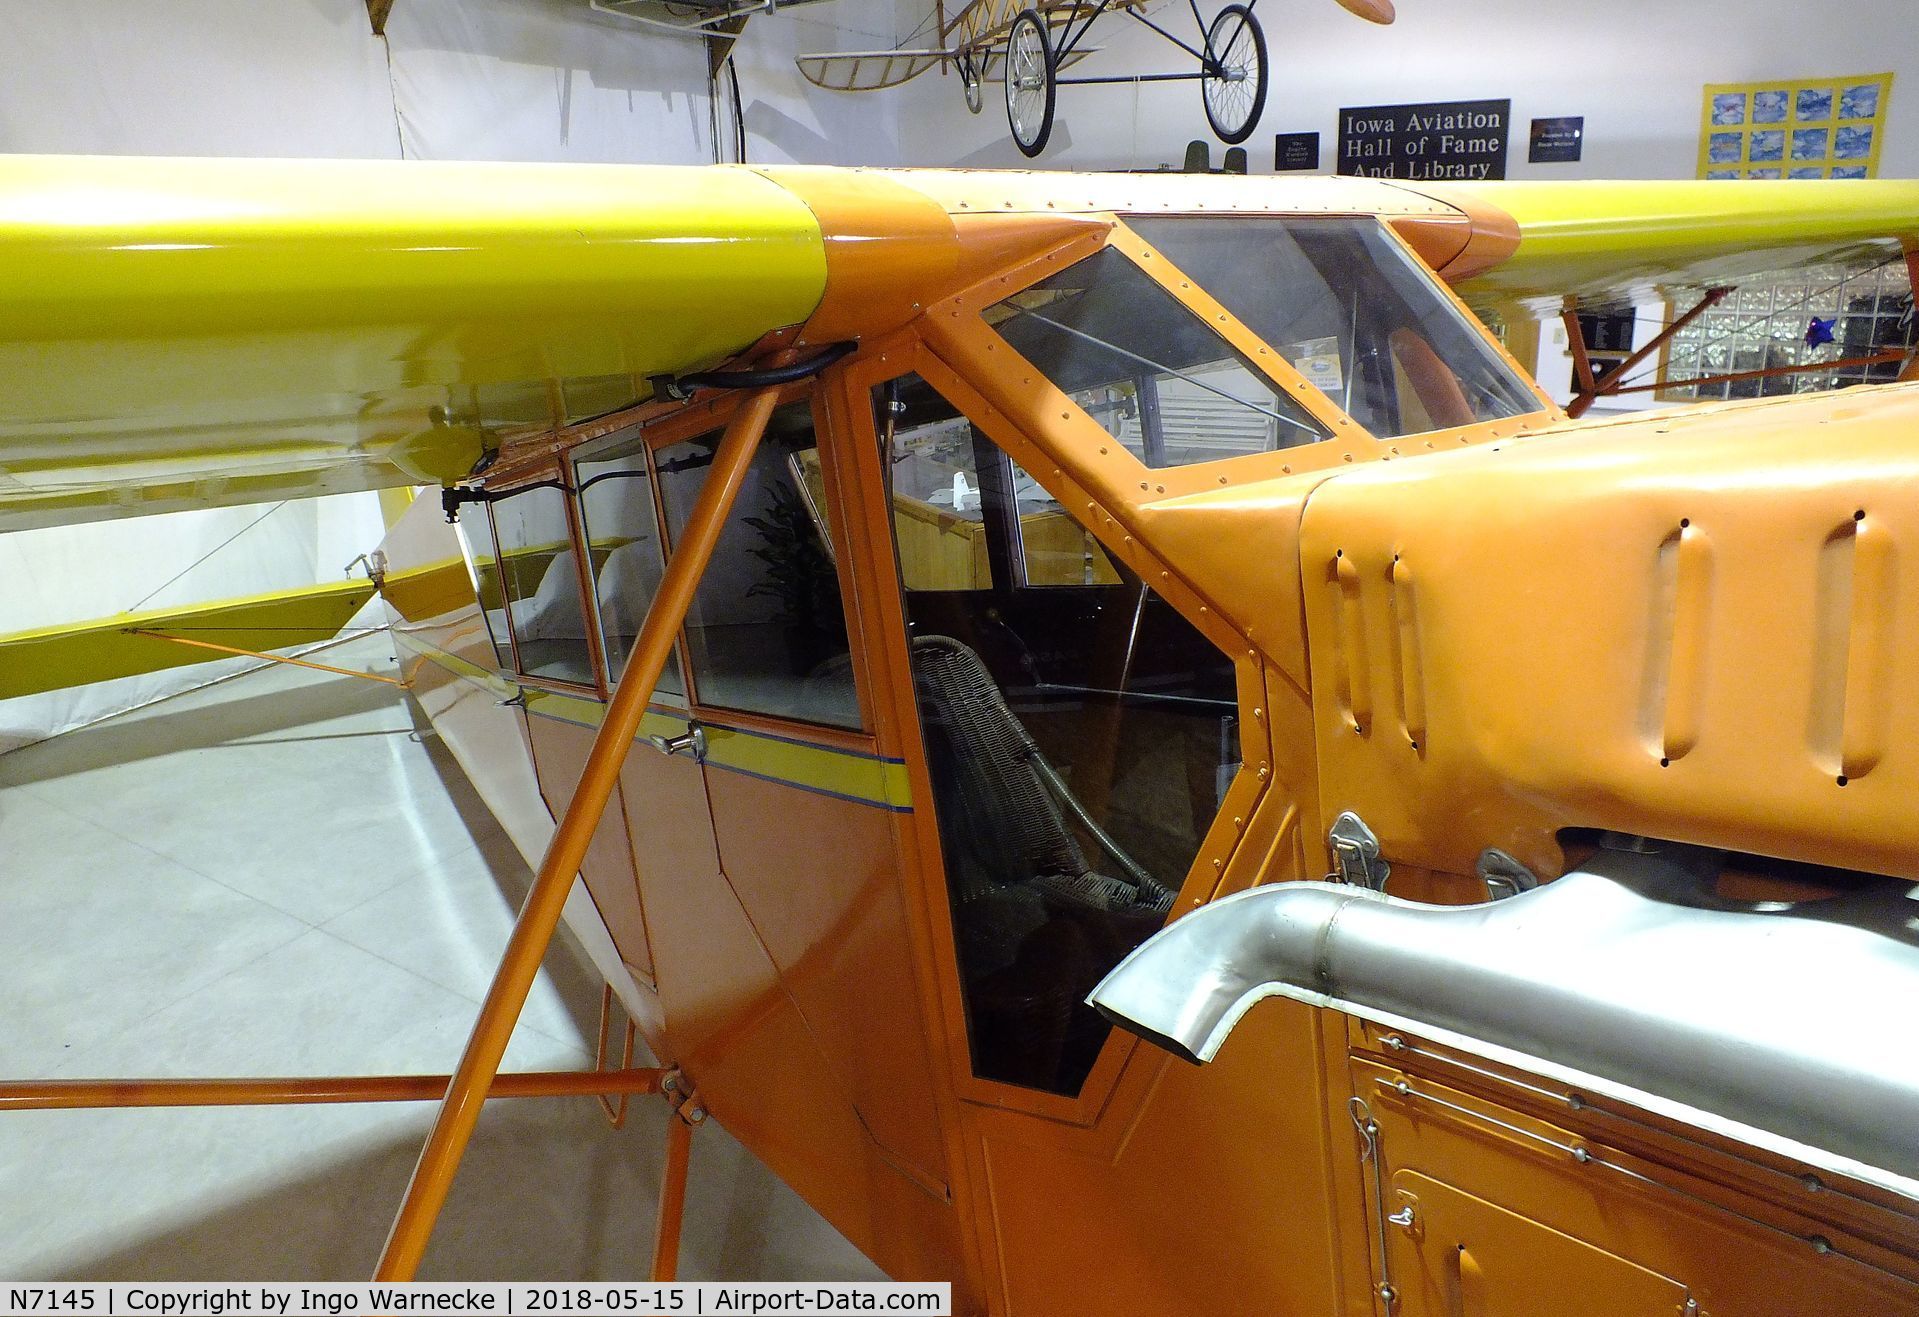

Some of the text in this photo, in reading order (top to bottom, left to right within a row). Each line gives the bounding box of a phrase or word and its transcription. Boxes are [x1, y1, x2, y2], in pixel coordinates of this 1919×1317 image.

[1347, 112, 1500, 134] Iowa Aviation
[1346, 135, 1500, 158] Hall of Fame
[1354, 160, 1491, 180] And Library
